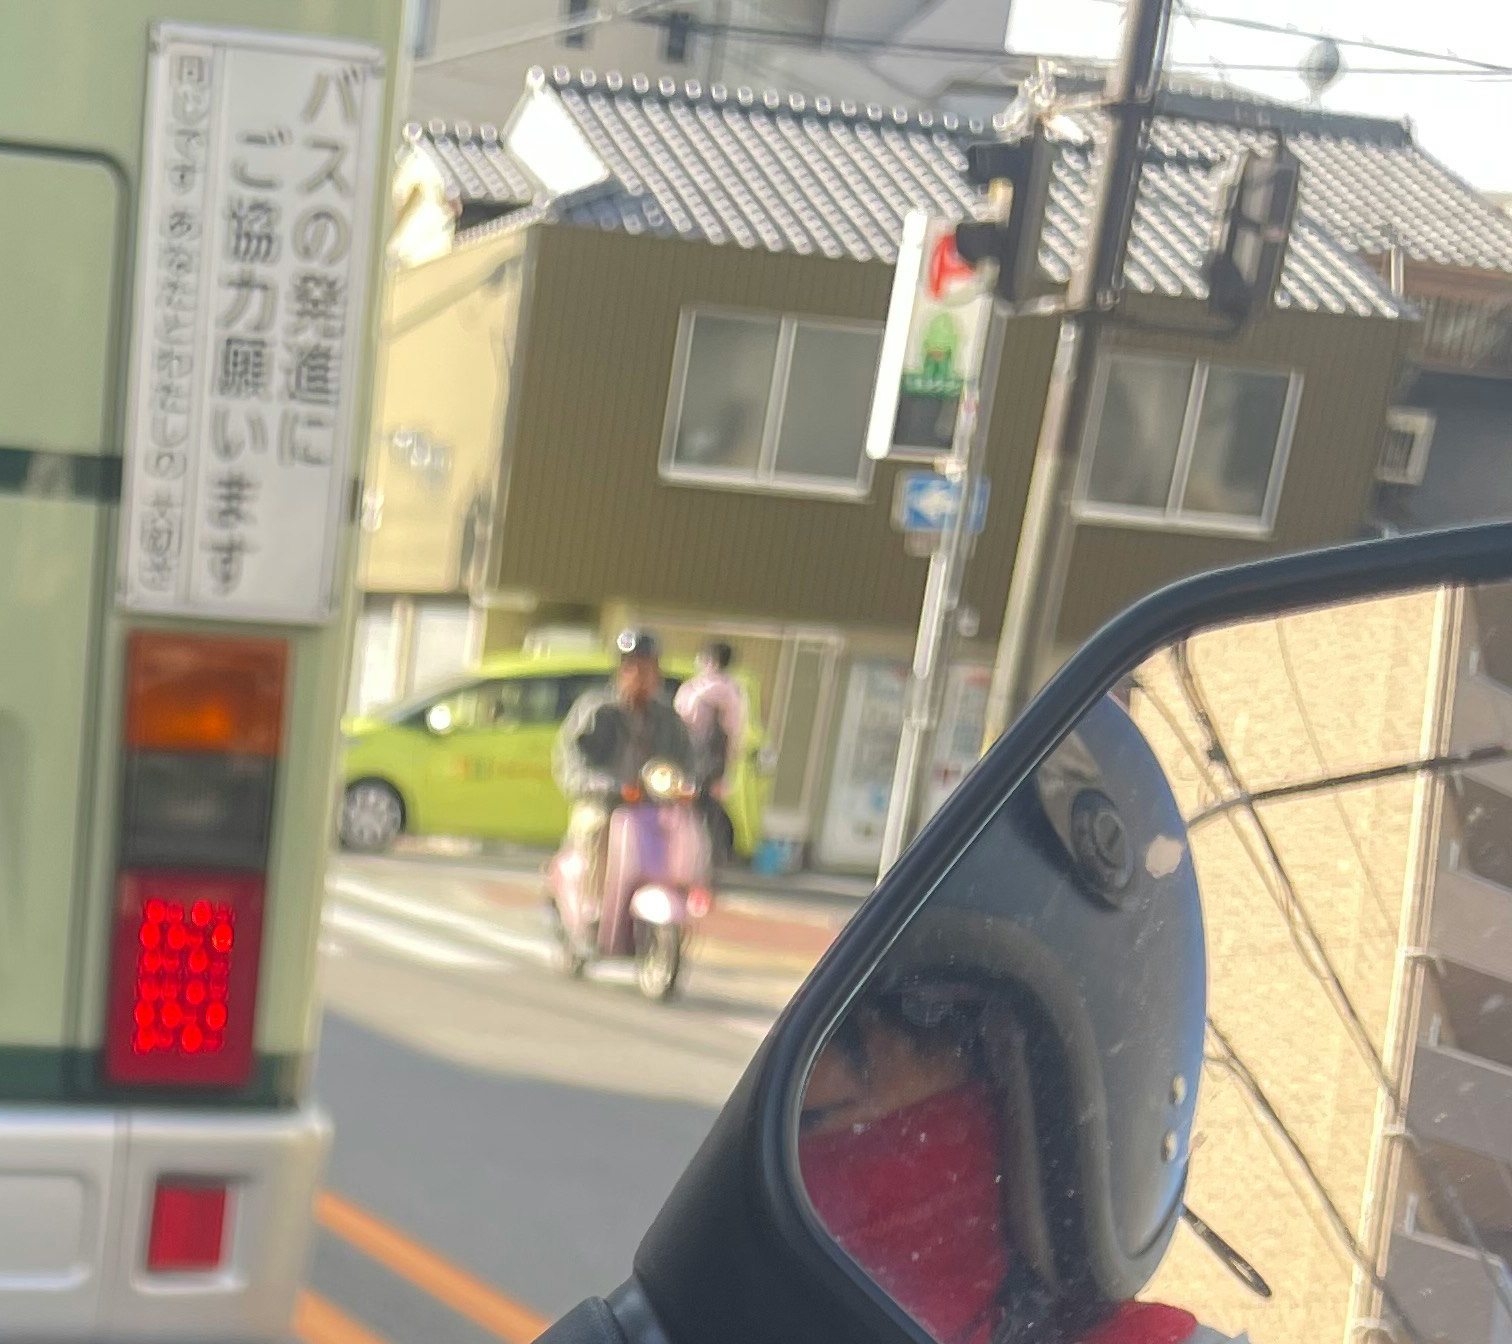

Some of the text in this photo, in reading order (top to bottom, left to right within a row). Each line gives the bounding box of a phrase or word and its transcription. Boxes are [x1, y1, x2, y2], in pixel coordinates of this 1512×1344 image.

[202, 127, 292, 594] ご協力願います
